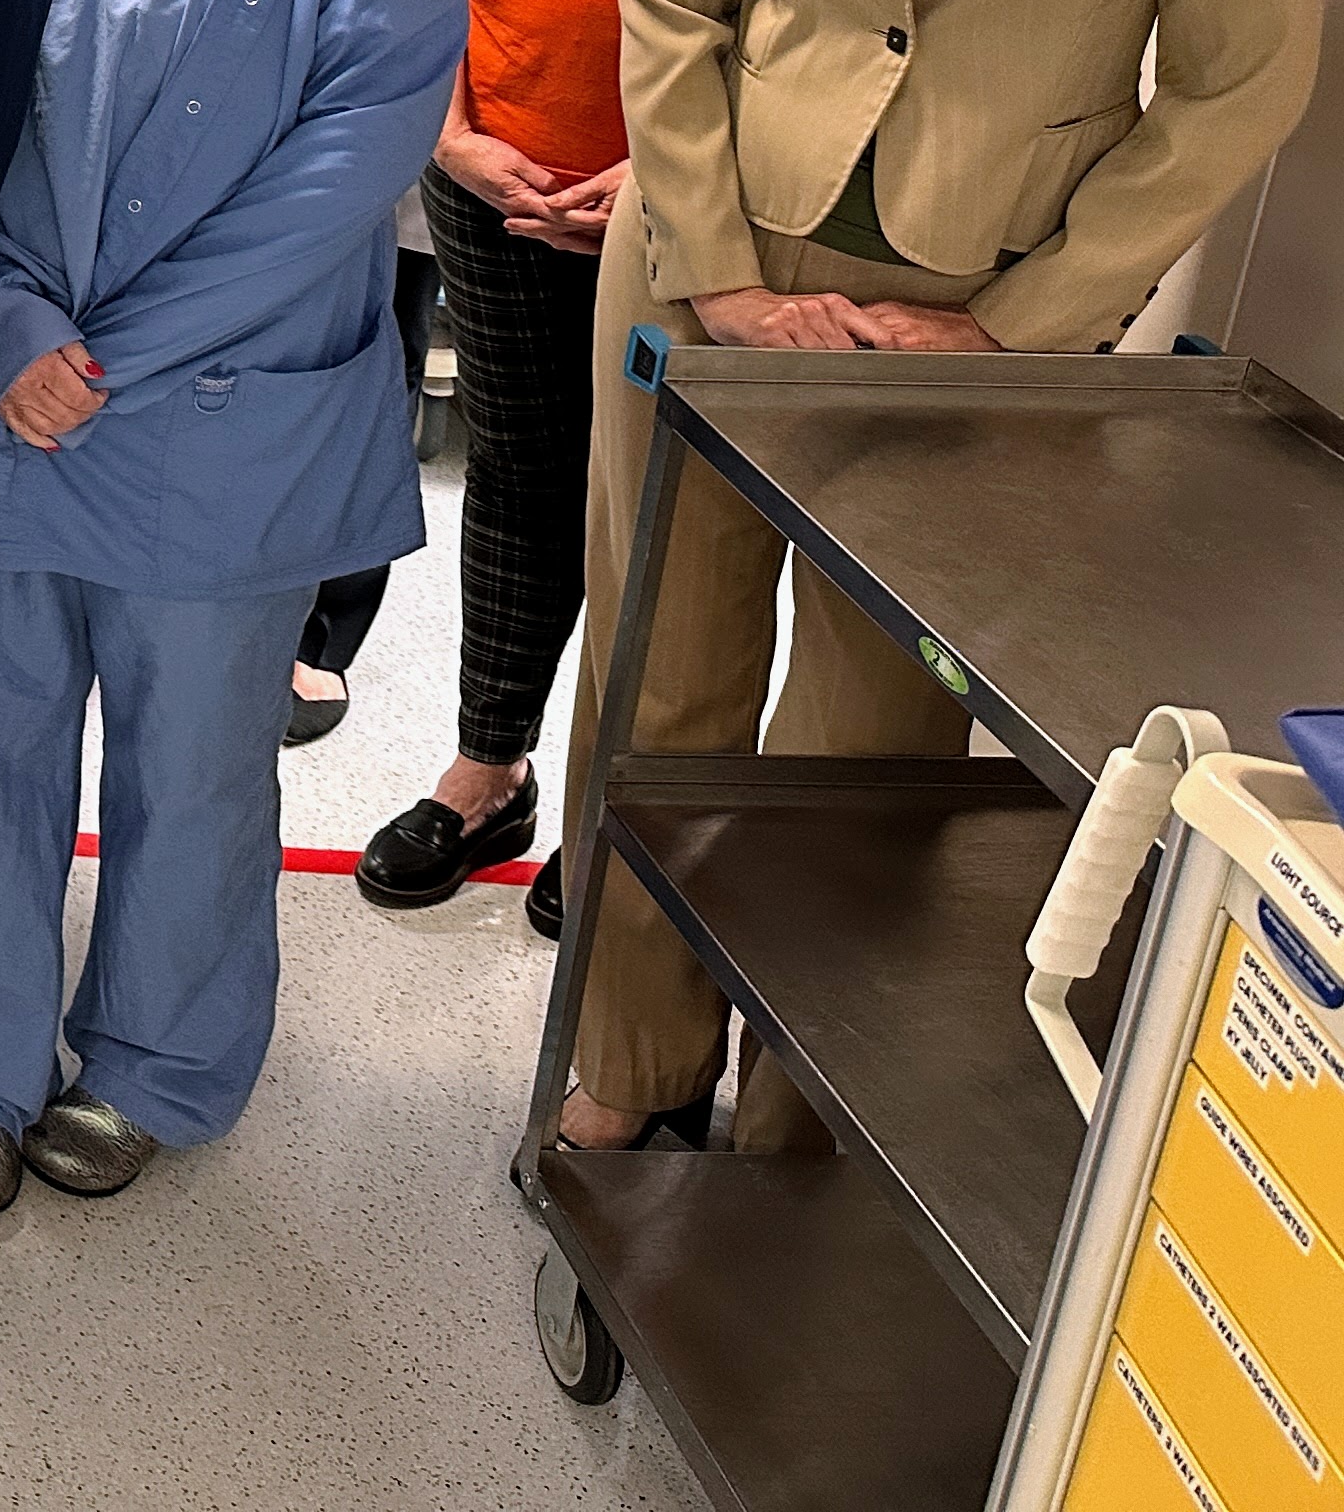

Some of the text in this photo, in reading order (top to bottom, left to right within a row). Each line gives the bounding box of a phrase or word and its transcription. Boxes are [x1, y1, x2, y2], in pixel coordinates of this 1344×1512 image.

[1271, 851, 1302, 889] LIGHT
[1300, 884, 1344, 938] SOURCE
[1232, 1001, 1259, 1041] PENIS
[1237, 976, 1317, 1080] CATHETER PLUGS
[1243, 951, 1292, 1015] SPECIMEN
[1226, 1026, 1268, 1081] KY JELLY
[1200, 1096, 1310, 1248] GUIDE WIRES ASSORTED
[1159, 1233, 1320, 1472] CATHETERS 2 WAY ASSORTED SIZES
[1117, 1358, 1164, 1436] CATHETERS
[1164, 1435, 1173, 1451] 3
[1172, 1445, 1196, 1485] WAY
